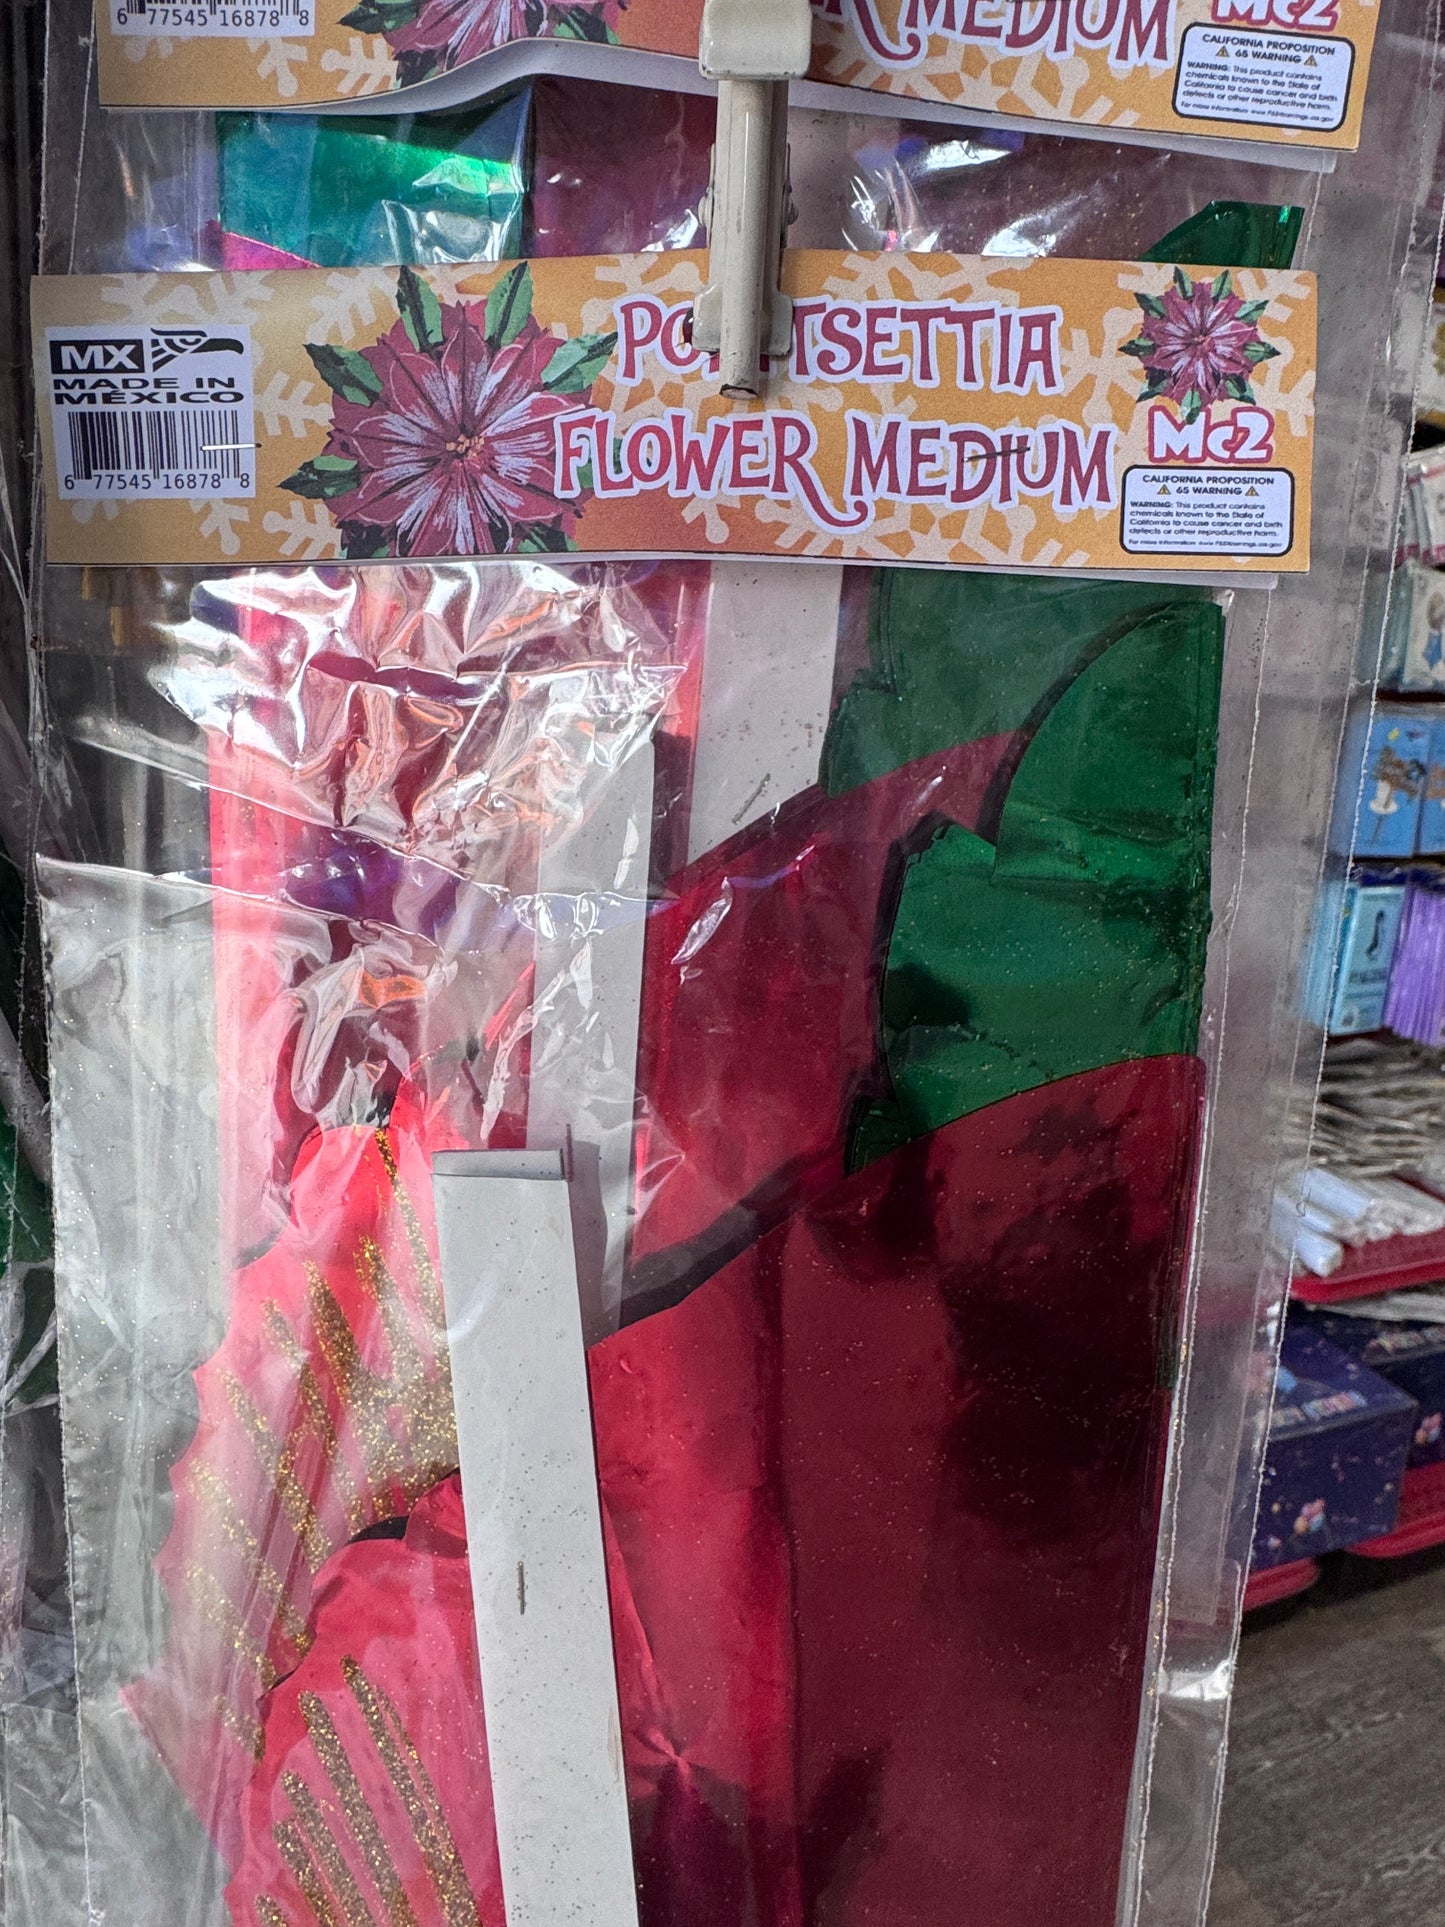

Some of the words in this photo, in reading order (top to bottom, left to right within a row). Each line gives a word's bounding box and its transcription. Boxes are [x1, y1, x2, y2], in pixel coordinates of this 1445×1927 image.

[116, 8, 129, 26] 6
[149, 9, 209, 27] 77545
[220, 10, 281, 27] 16878
[298, 10, 310, 26] 8
[1201, 33, 1265, 48] CALIFORNIA
[1266, 40, 1336, 56] PROPOSITION
[1234, 48, 1249, 59] 65
[1250, 50, 1302, 64] WARNING
[1184, 70, 1230, 82] chemicals
[1230, 74, 1260, 85] known
[1260, 78, 1270, 86] to
[1249, 67, 1285, 78] product
[1237, 85, 1265, 95] cause
[1265, 89, 1298, 99] cancer
[1298, 91, 1318, 101] and
[617, 298, 1059, 391] POTSETTIA
[59, 344, 140, 371] MX
[52, 377, 180, 391] MADE
[194, 376, 236, 390] IN
[53, 389, 245, 406] MÉXICO
[1148, 404, 1275, 464] Mc2
[557, 412, 869, 529] FLOWER
[849, 416, 1113, 507] MEDIUM
[63, 474, 75, 491] 6
[93, 474, 151, 491] 77545
[163, 473, 222, 490] 16878
[239, 472, 251, 489] 8
[1141, 474, 1204, 484] CALIFORNIA
[1206, 476, 1275, 485] PROPOSITION
[1175, 486, 1190, 495] 65
[1191, 486, 1243, 495] WARNING
[1128, 510, 1174, 518] chemicals
[1175, 510, 1204, 518] known
[1175, 501, 1192, 509] This
[1192, 502, 1227, 511] product
[1243, 520, 1263, 528] and
